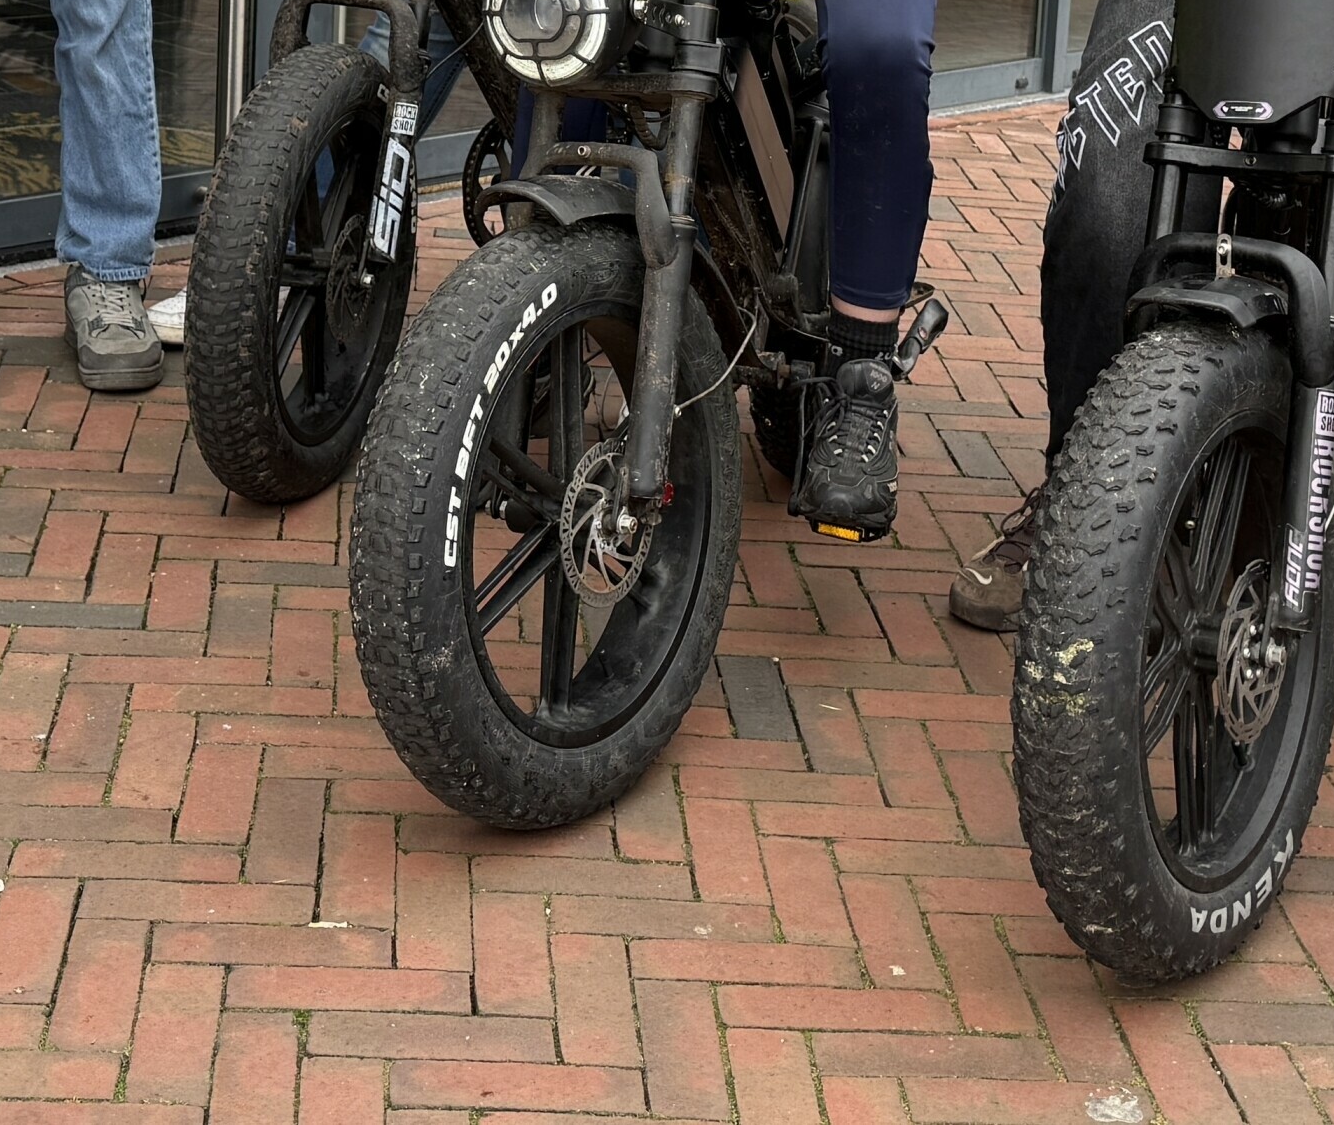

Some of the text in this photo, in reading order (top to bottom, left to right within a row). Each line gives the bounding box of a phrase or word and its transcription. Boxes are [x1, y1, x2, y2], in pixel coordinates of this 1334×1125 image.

[444, 282, 558, 567] CST BFT 20x4.0
[1190, 828, 1294, 934] KENDA
